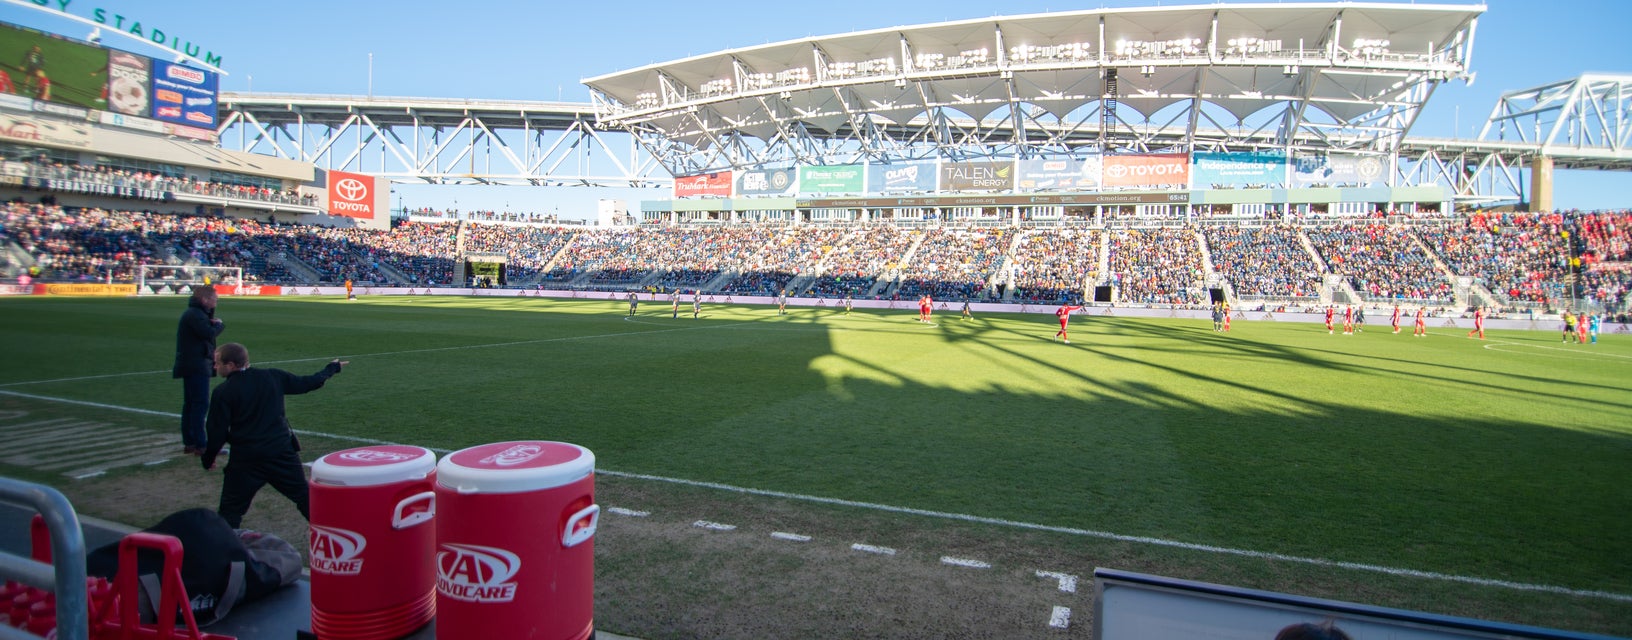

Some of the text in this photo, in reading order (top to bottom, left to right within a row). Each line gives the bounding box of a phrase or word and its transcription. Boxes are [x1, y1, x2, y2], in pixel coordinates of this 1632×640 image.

[93, 7, 222, 67] STADIUM
[1130, 163, 1184, 176] TOYOTA
[1202, 161, 1263, 171] Independence
[945, 167, 994, 180] TALEN
[48, 180, 115, 194] SEBASTIEN
[120, 187, 133, 196] LE
[677, 181, 708, 190] TruMark
[973, 180, 1008, 188] ENERGY
[332, 200, 370, 213] TOYOTA
